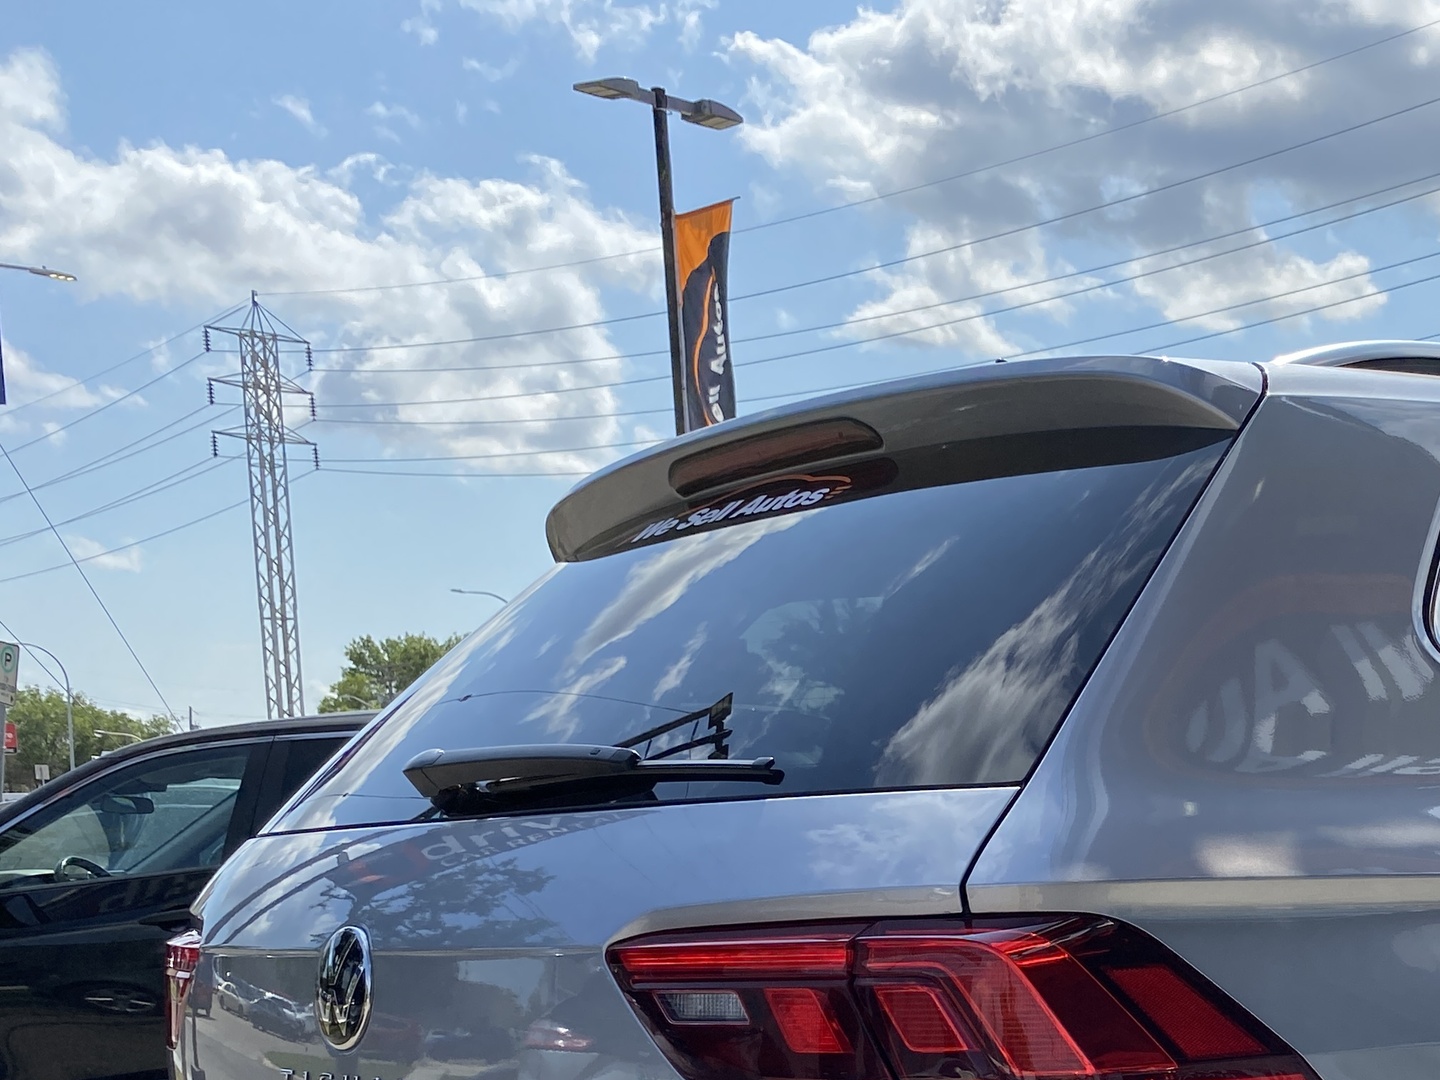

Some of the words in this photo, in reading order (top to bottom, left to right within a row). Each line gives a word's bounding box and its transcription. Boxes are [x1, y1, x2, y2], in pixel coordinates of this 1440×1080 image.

[709, 384, 724, 422] ell
[630, 516, 680, 544] We
[676, 499, 745, 531] Sell
[731, 487, 831, 519] Autos
